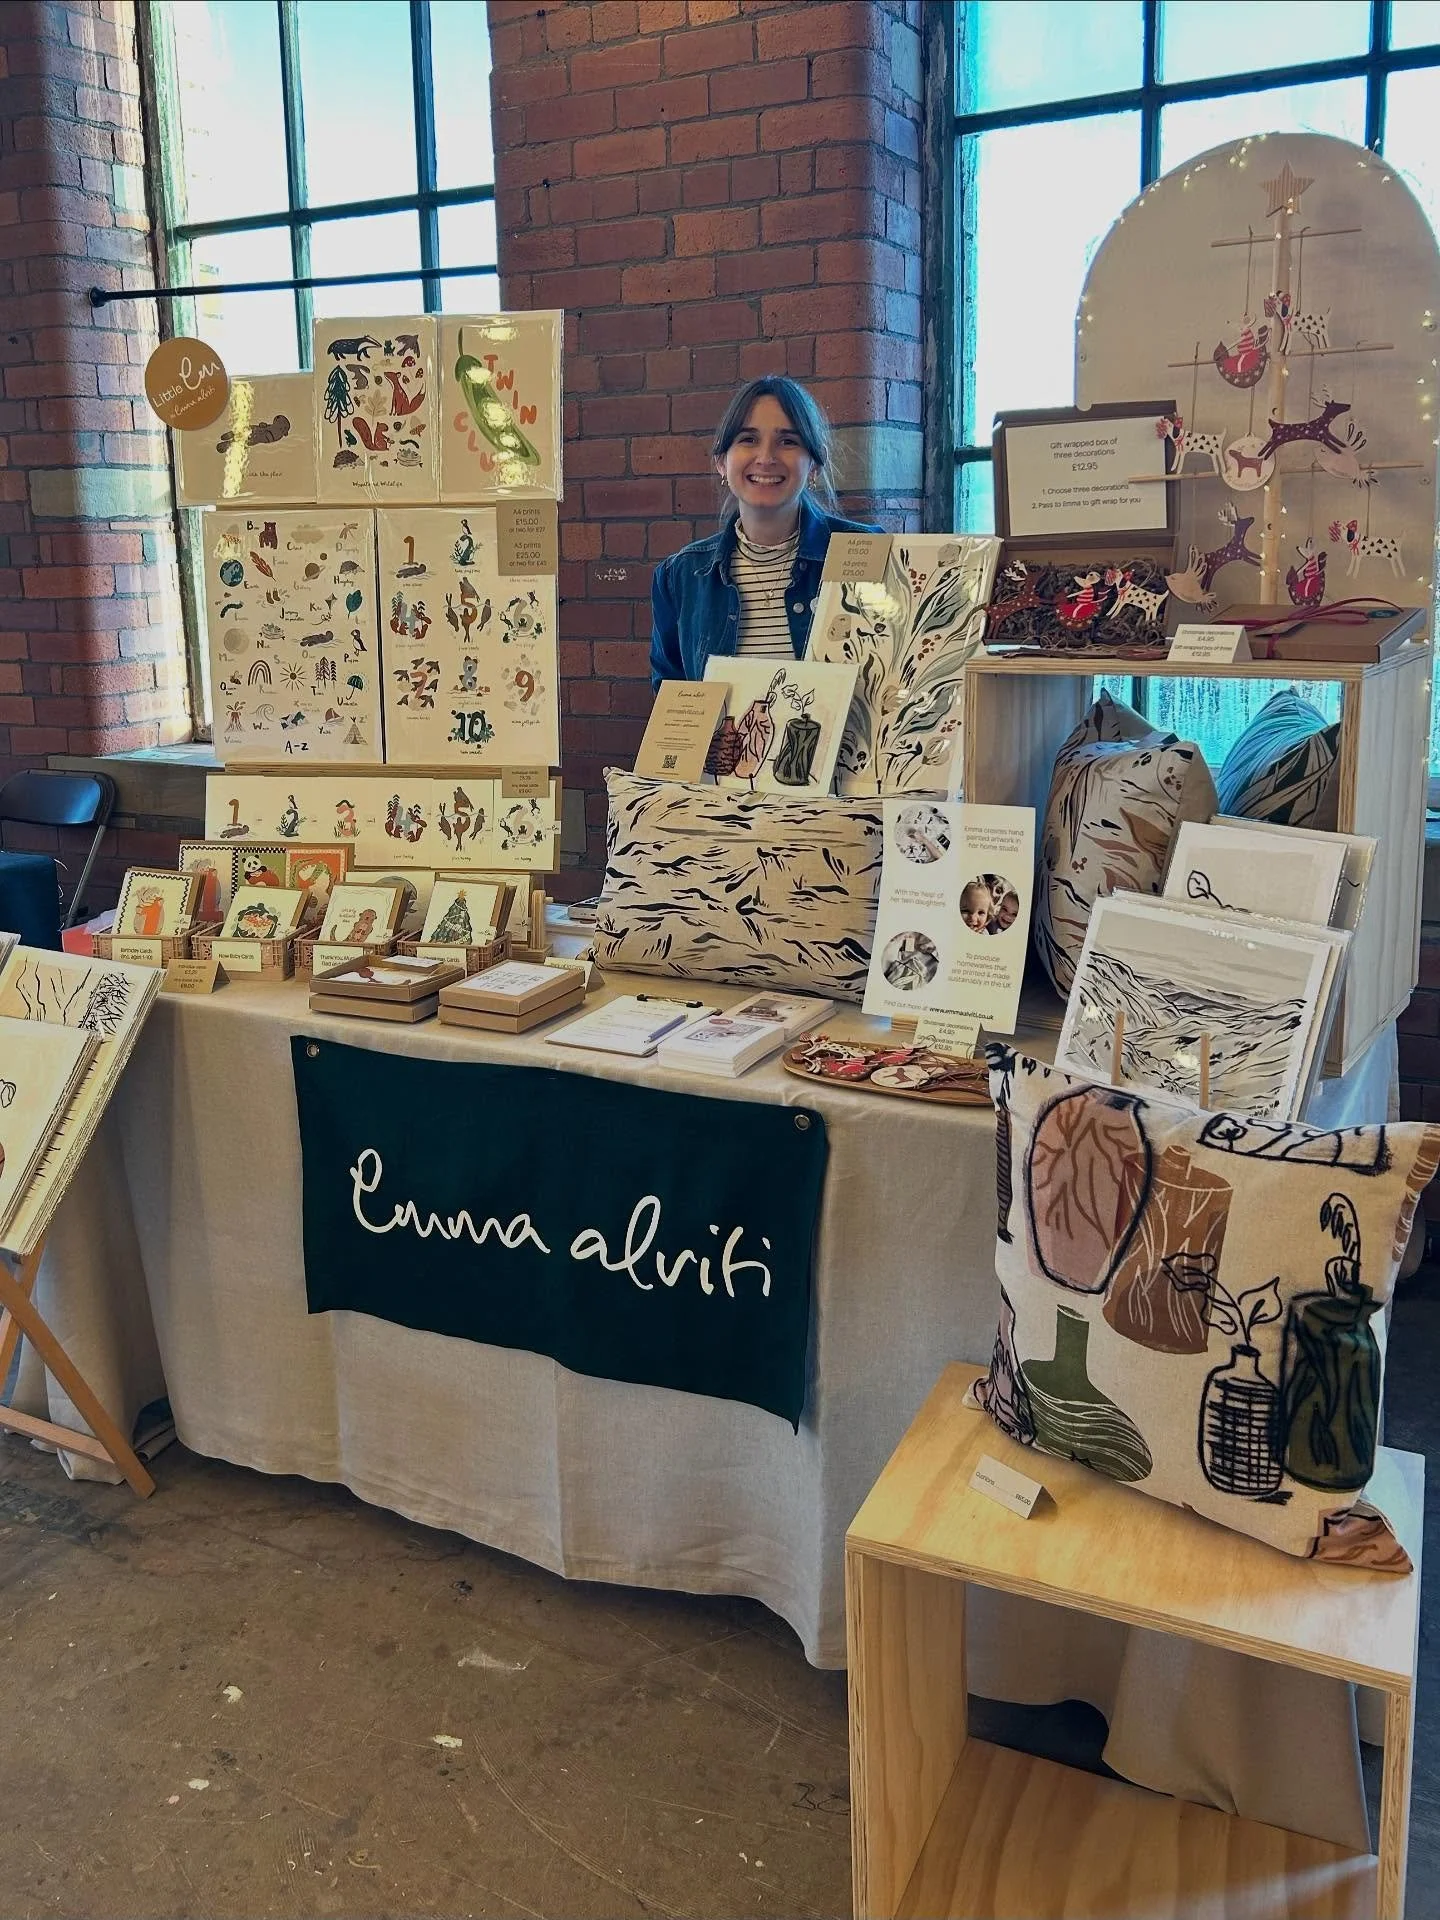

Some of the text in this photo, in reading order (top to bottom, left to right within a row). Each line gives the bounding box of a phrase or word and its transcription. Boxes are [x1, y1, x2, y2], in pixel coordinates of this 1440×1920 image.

[152, 384, 184, 408] Little
[1050, 441, 1062, 449] Gift
[1063, 439, 1094, 450] wrapped
[1110, 437, 1118, 445] of
[1053, 448, 1116, 459] three decorations
[1072, 461, 1098, 471] £12.95
[1047, 487, 1072, 495] Choose
[1072, 485, 1091, 493] three
[1091, 483, 1129, 492] decorations
[1062, 499, 1082, 507] Emma
[1091, 498, 1102, 507] gift
[1102, 497, 1119, 506] wrap
[1129, 496, 1142, 504] you
[515, 518, 539, 526] £15.00
[523, 542, 541, 550] prints
[516, 551, 541, 559] £25.00
[915, 899, 947, 908] daughters
[973, 954, 1000, 962] produce
[957, 961, 993, 970] homewares
[962, 969, 986, 977] printed
[947, 976, 982, 985] sustainably
[929, 1007, 994, 1020] www.emmaalviti.co.uk
[570, 1195, 772, 1298] alviti
